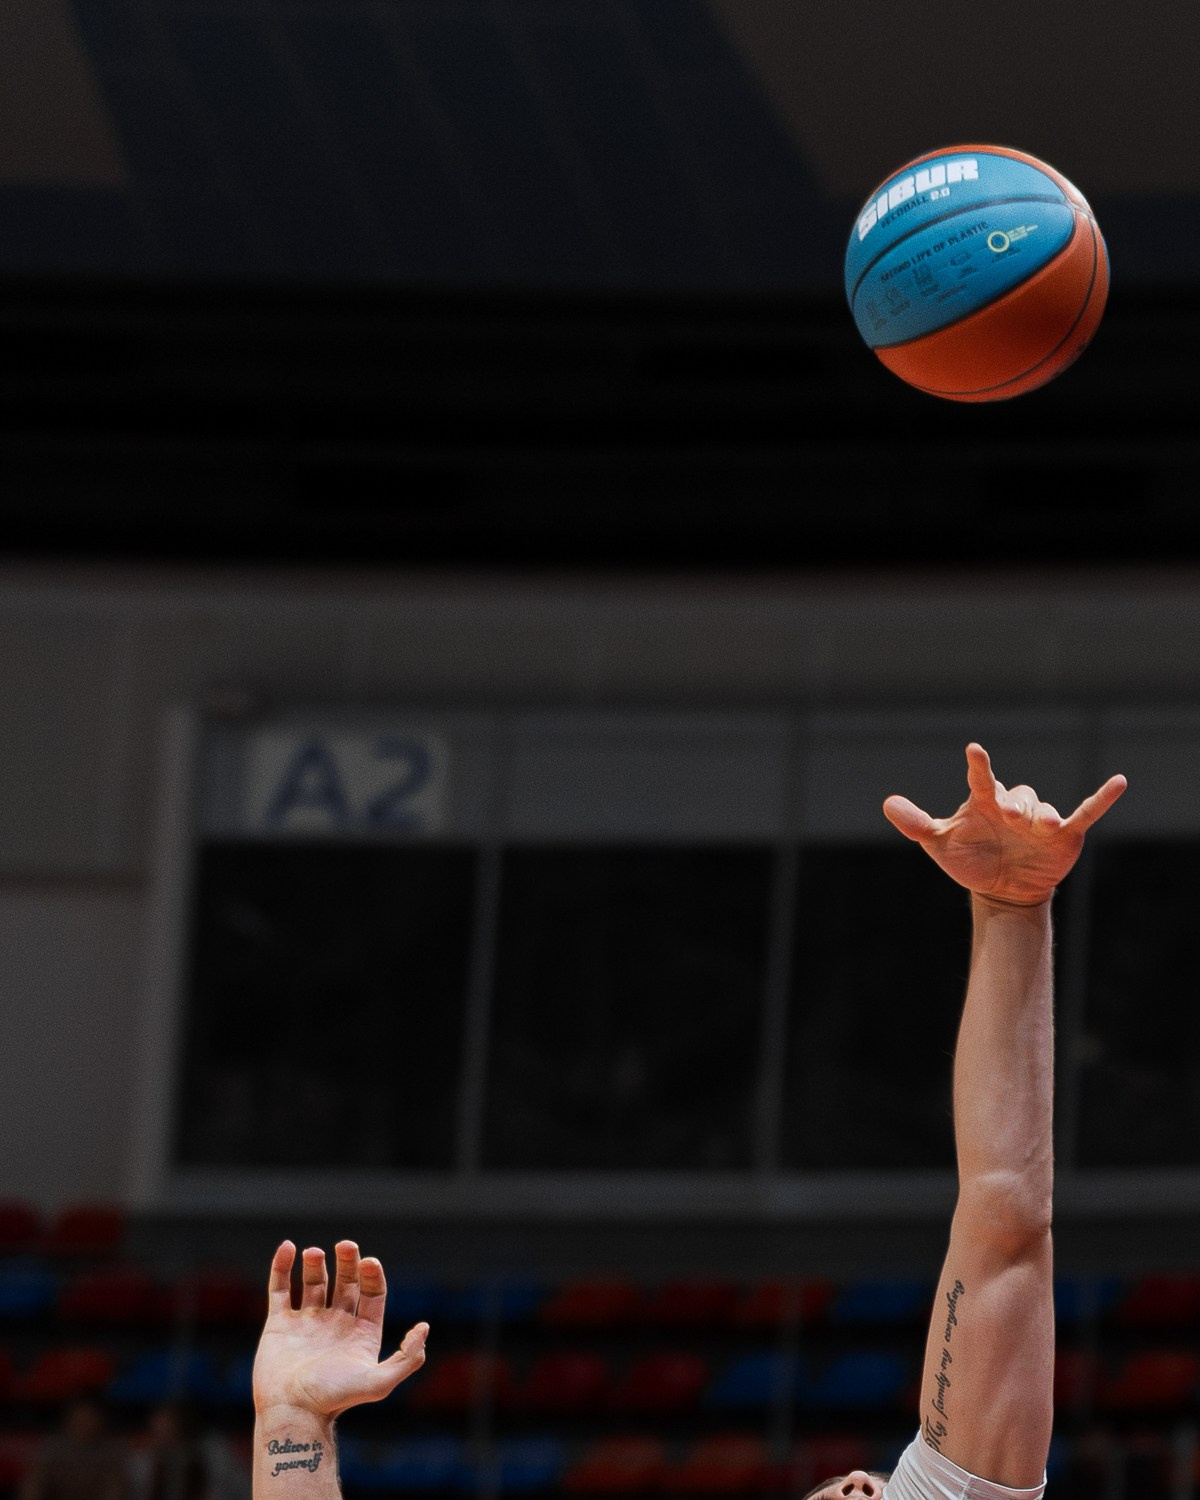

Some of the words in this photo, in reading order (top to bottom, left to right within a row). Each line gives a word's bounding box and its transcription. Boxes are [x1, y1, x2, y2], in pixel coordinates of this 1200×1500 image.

[858, 159, 979, 242] SIBUR
[268, 1438, 311, 1456] Believe
[311, 1440, 325, 1451] in
[271, 1452, 324, 1477] yourself
